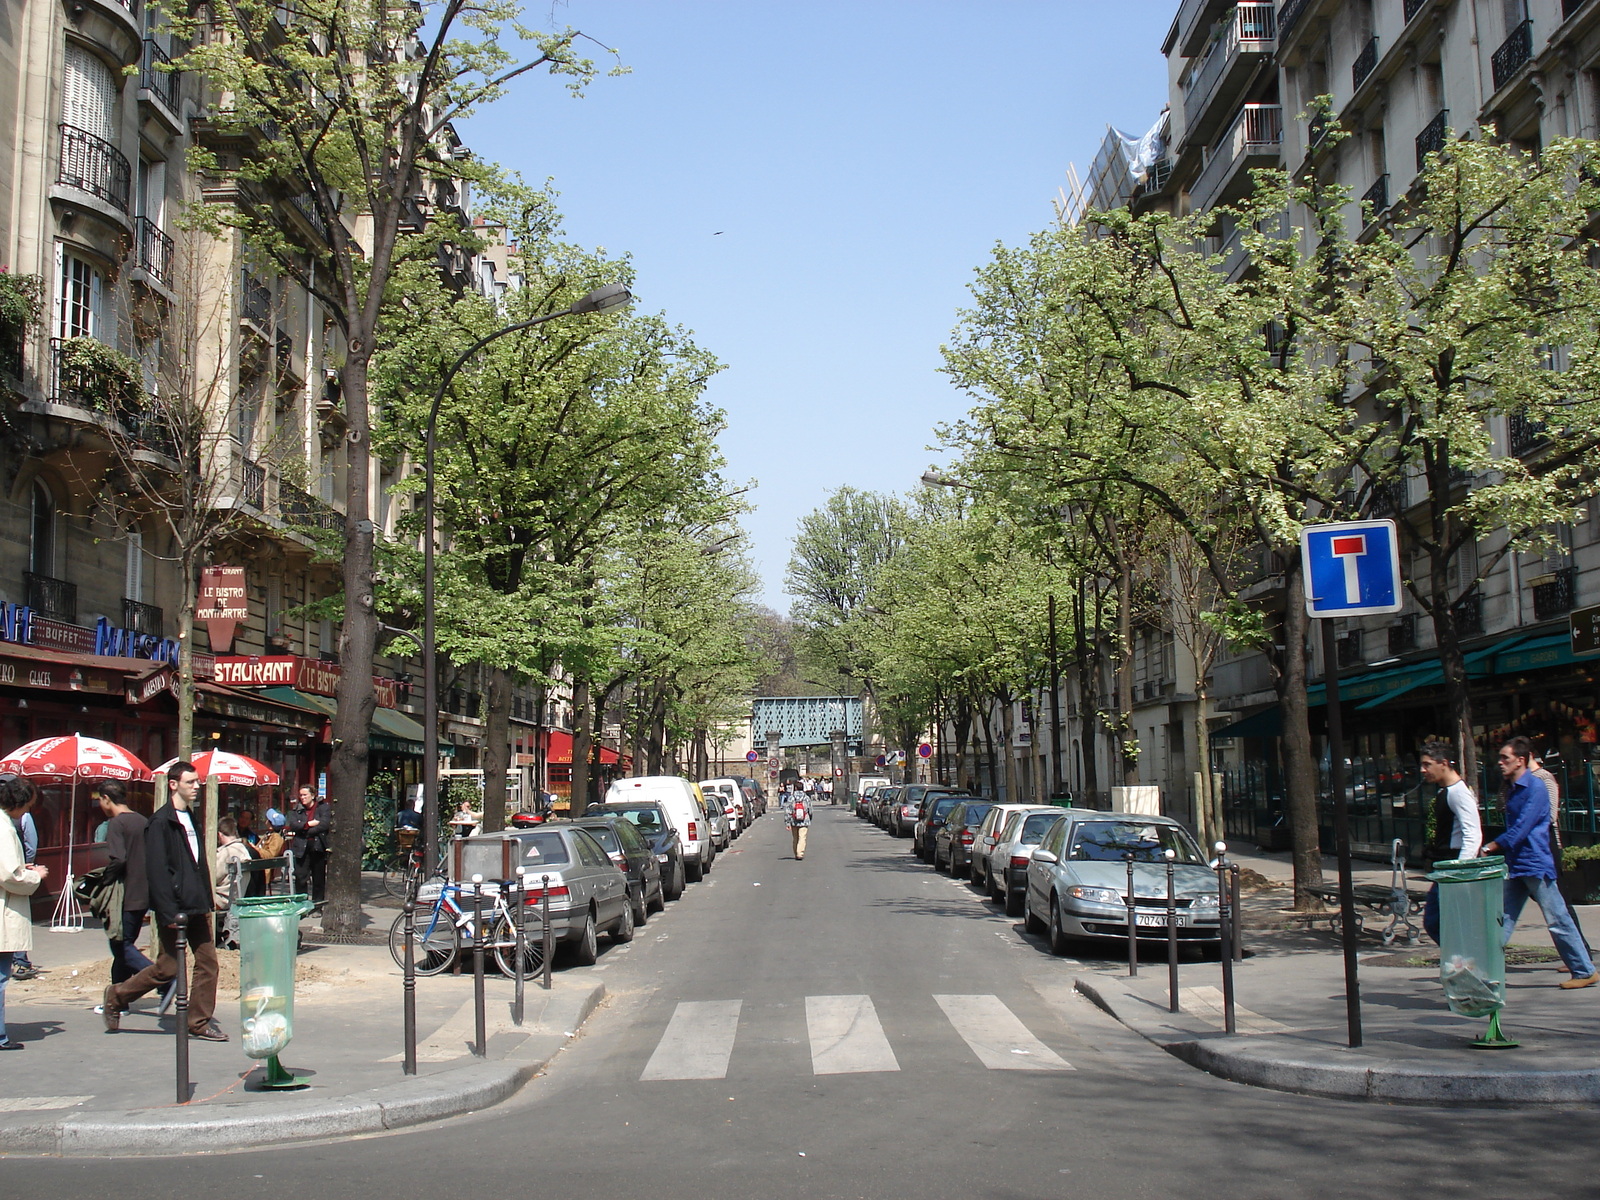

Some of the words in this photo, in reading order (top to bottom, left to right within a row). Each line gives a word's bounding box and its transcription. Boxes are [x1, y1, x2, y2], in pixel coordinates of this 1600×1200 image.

[204, 587, 214, 597] LE
[216, 587, 244, 598] BISTRO
[217, 598, 228, 608] DE
[197, 608, 247, 619] MONTMARTRE
[45, 626, 79, 645] BUFFET
[29, 670, 51, 687] GLACES
[214, 662, 294, 685] STAURANT
[306, 667, 316, 690] LE
[102, 766, 129, 778] Pression
[230, 774, 253, 785] Pression
